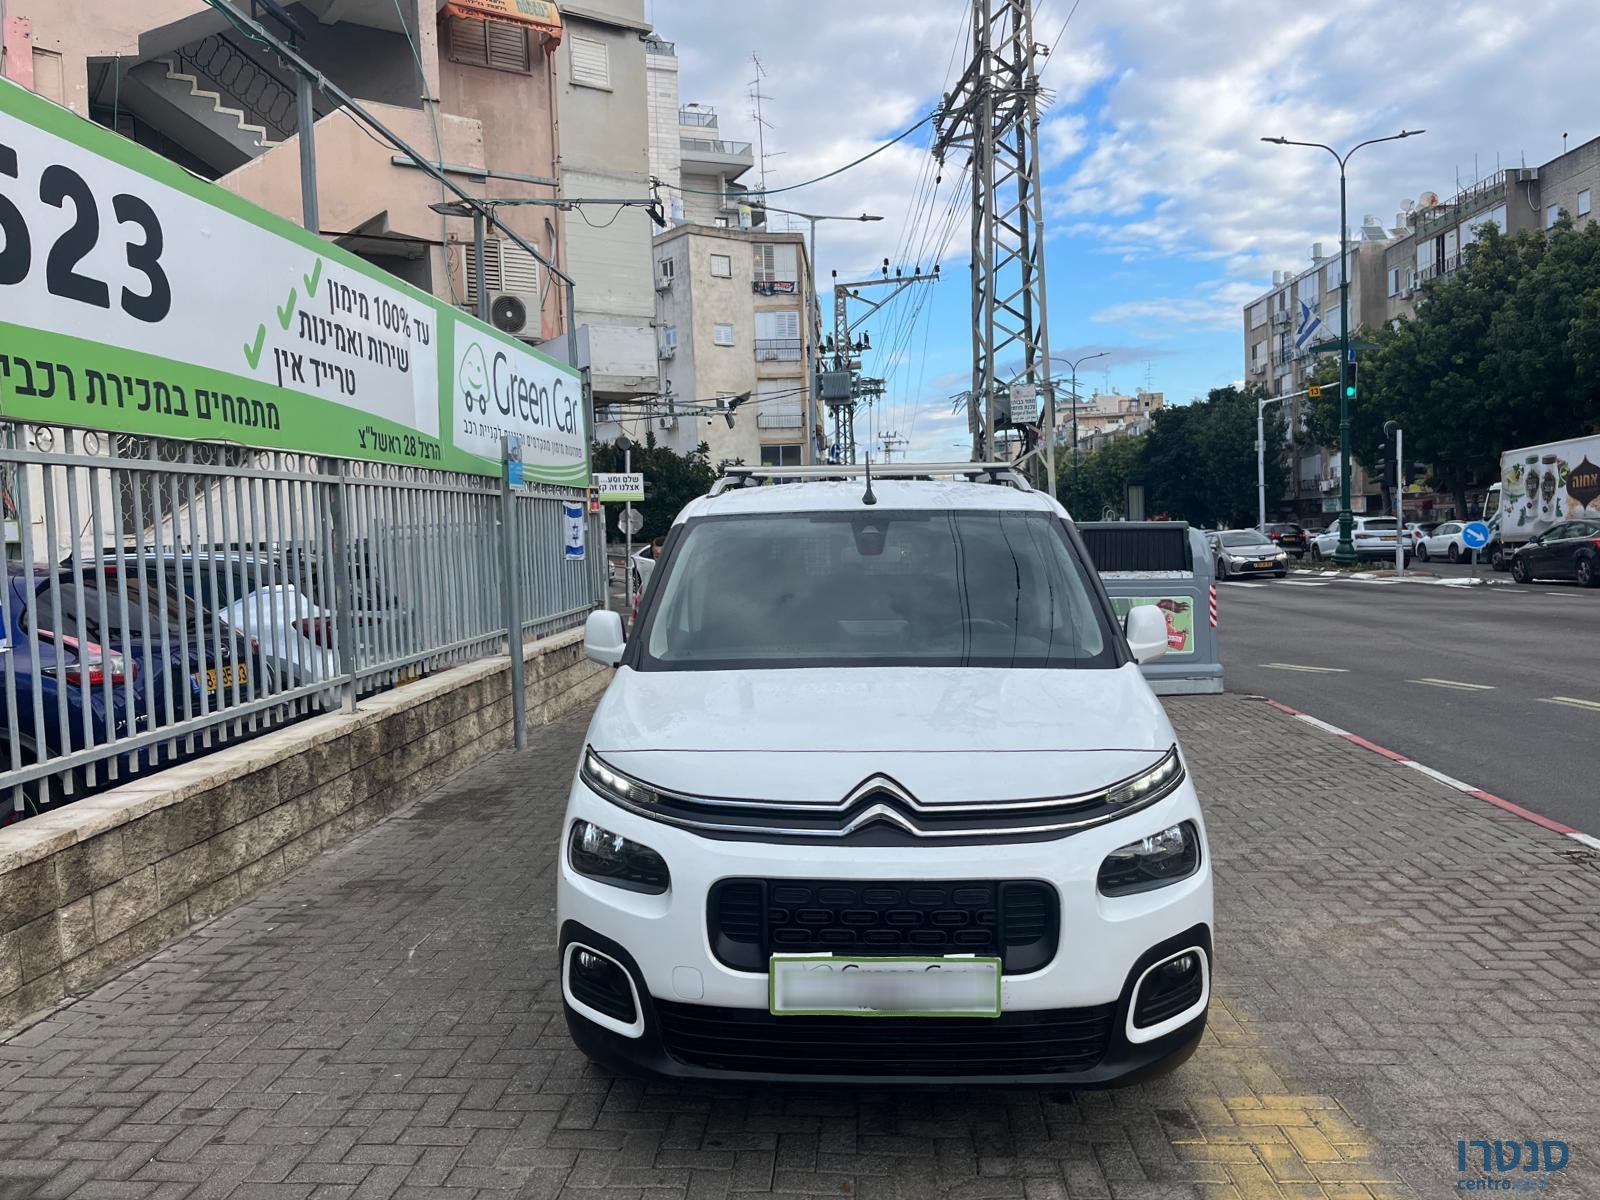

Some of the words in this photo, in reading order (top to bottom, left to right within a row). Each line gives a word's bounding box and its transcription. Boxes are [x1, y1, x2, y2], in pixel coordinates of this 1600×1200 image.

[327, 278, 370, 320] מימון
[374, 296, 411, 338] 100%
[298, 310, 364, 358] ואמינות
[413, 318, 430, 346] עד
[274, 347, 305, 388] אין
[368, 336, 409, 373] שירות
[84, 368, 188, 417] במכירת
[309, 358, 356, 396] טרייד
[493, 351, 551, 428] Green
[554, 378, 578, 436] Car
[194, 388, 280, 430] מתמחים
[464, 420, 478, 435] רכב
[404, 434, 416, 456] 28
[418, 436, 441, 460] הרצל
[1572, 473, 1598, 488] אחוה
